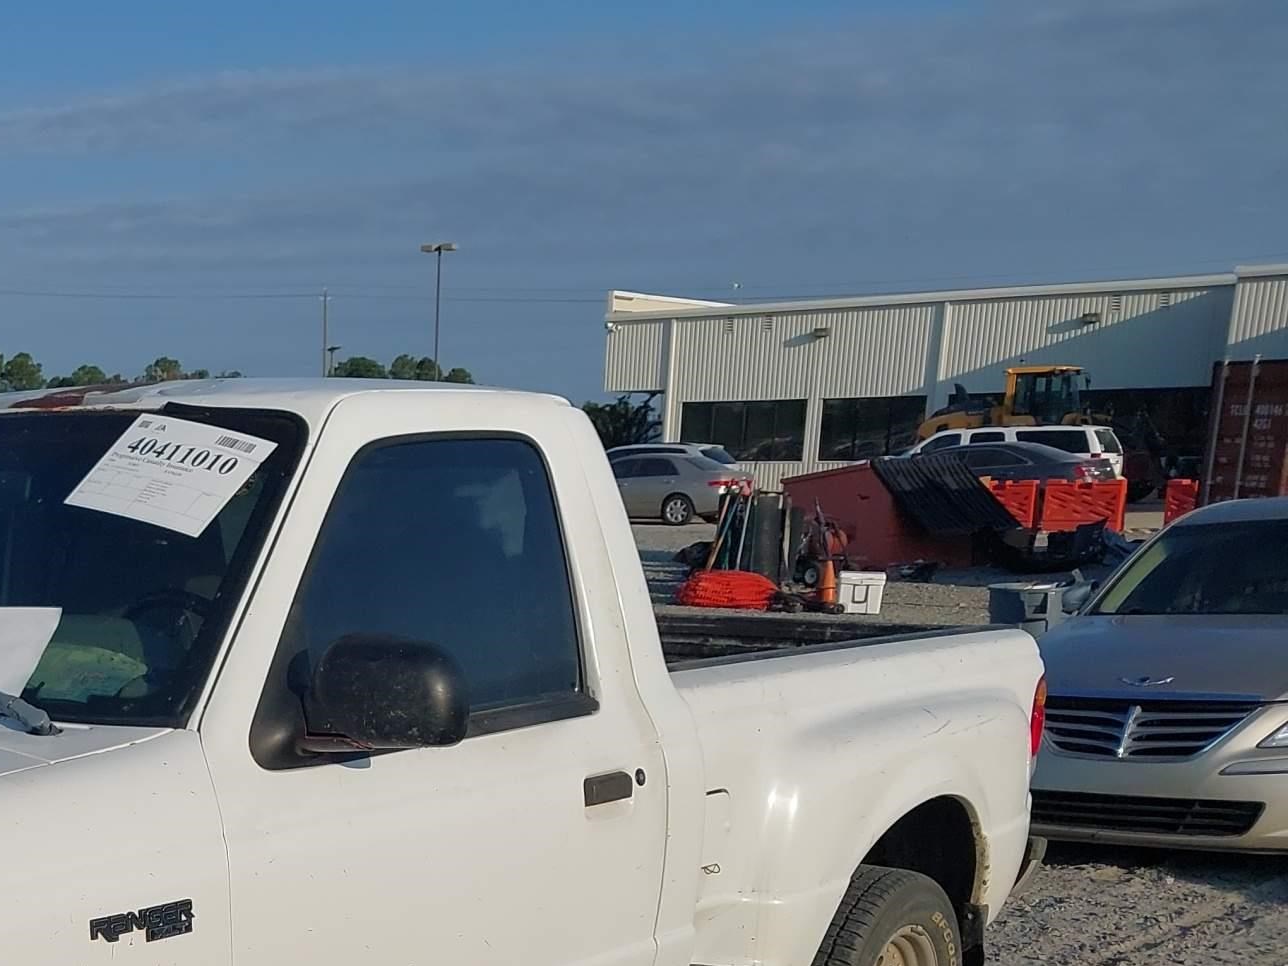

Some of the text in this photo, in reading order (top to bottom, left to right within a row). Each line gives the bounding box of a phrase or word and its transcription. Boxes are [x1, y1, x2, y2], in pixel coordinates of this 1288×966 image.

[127, 436, 239, 475] 40411010
[89, 898, 196, 942] RANGER
[146, 922, 192, 942] XLT
